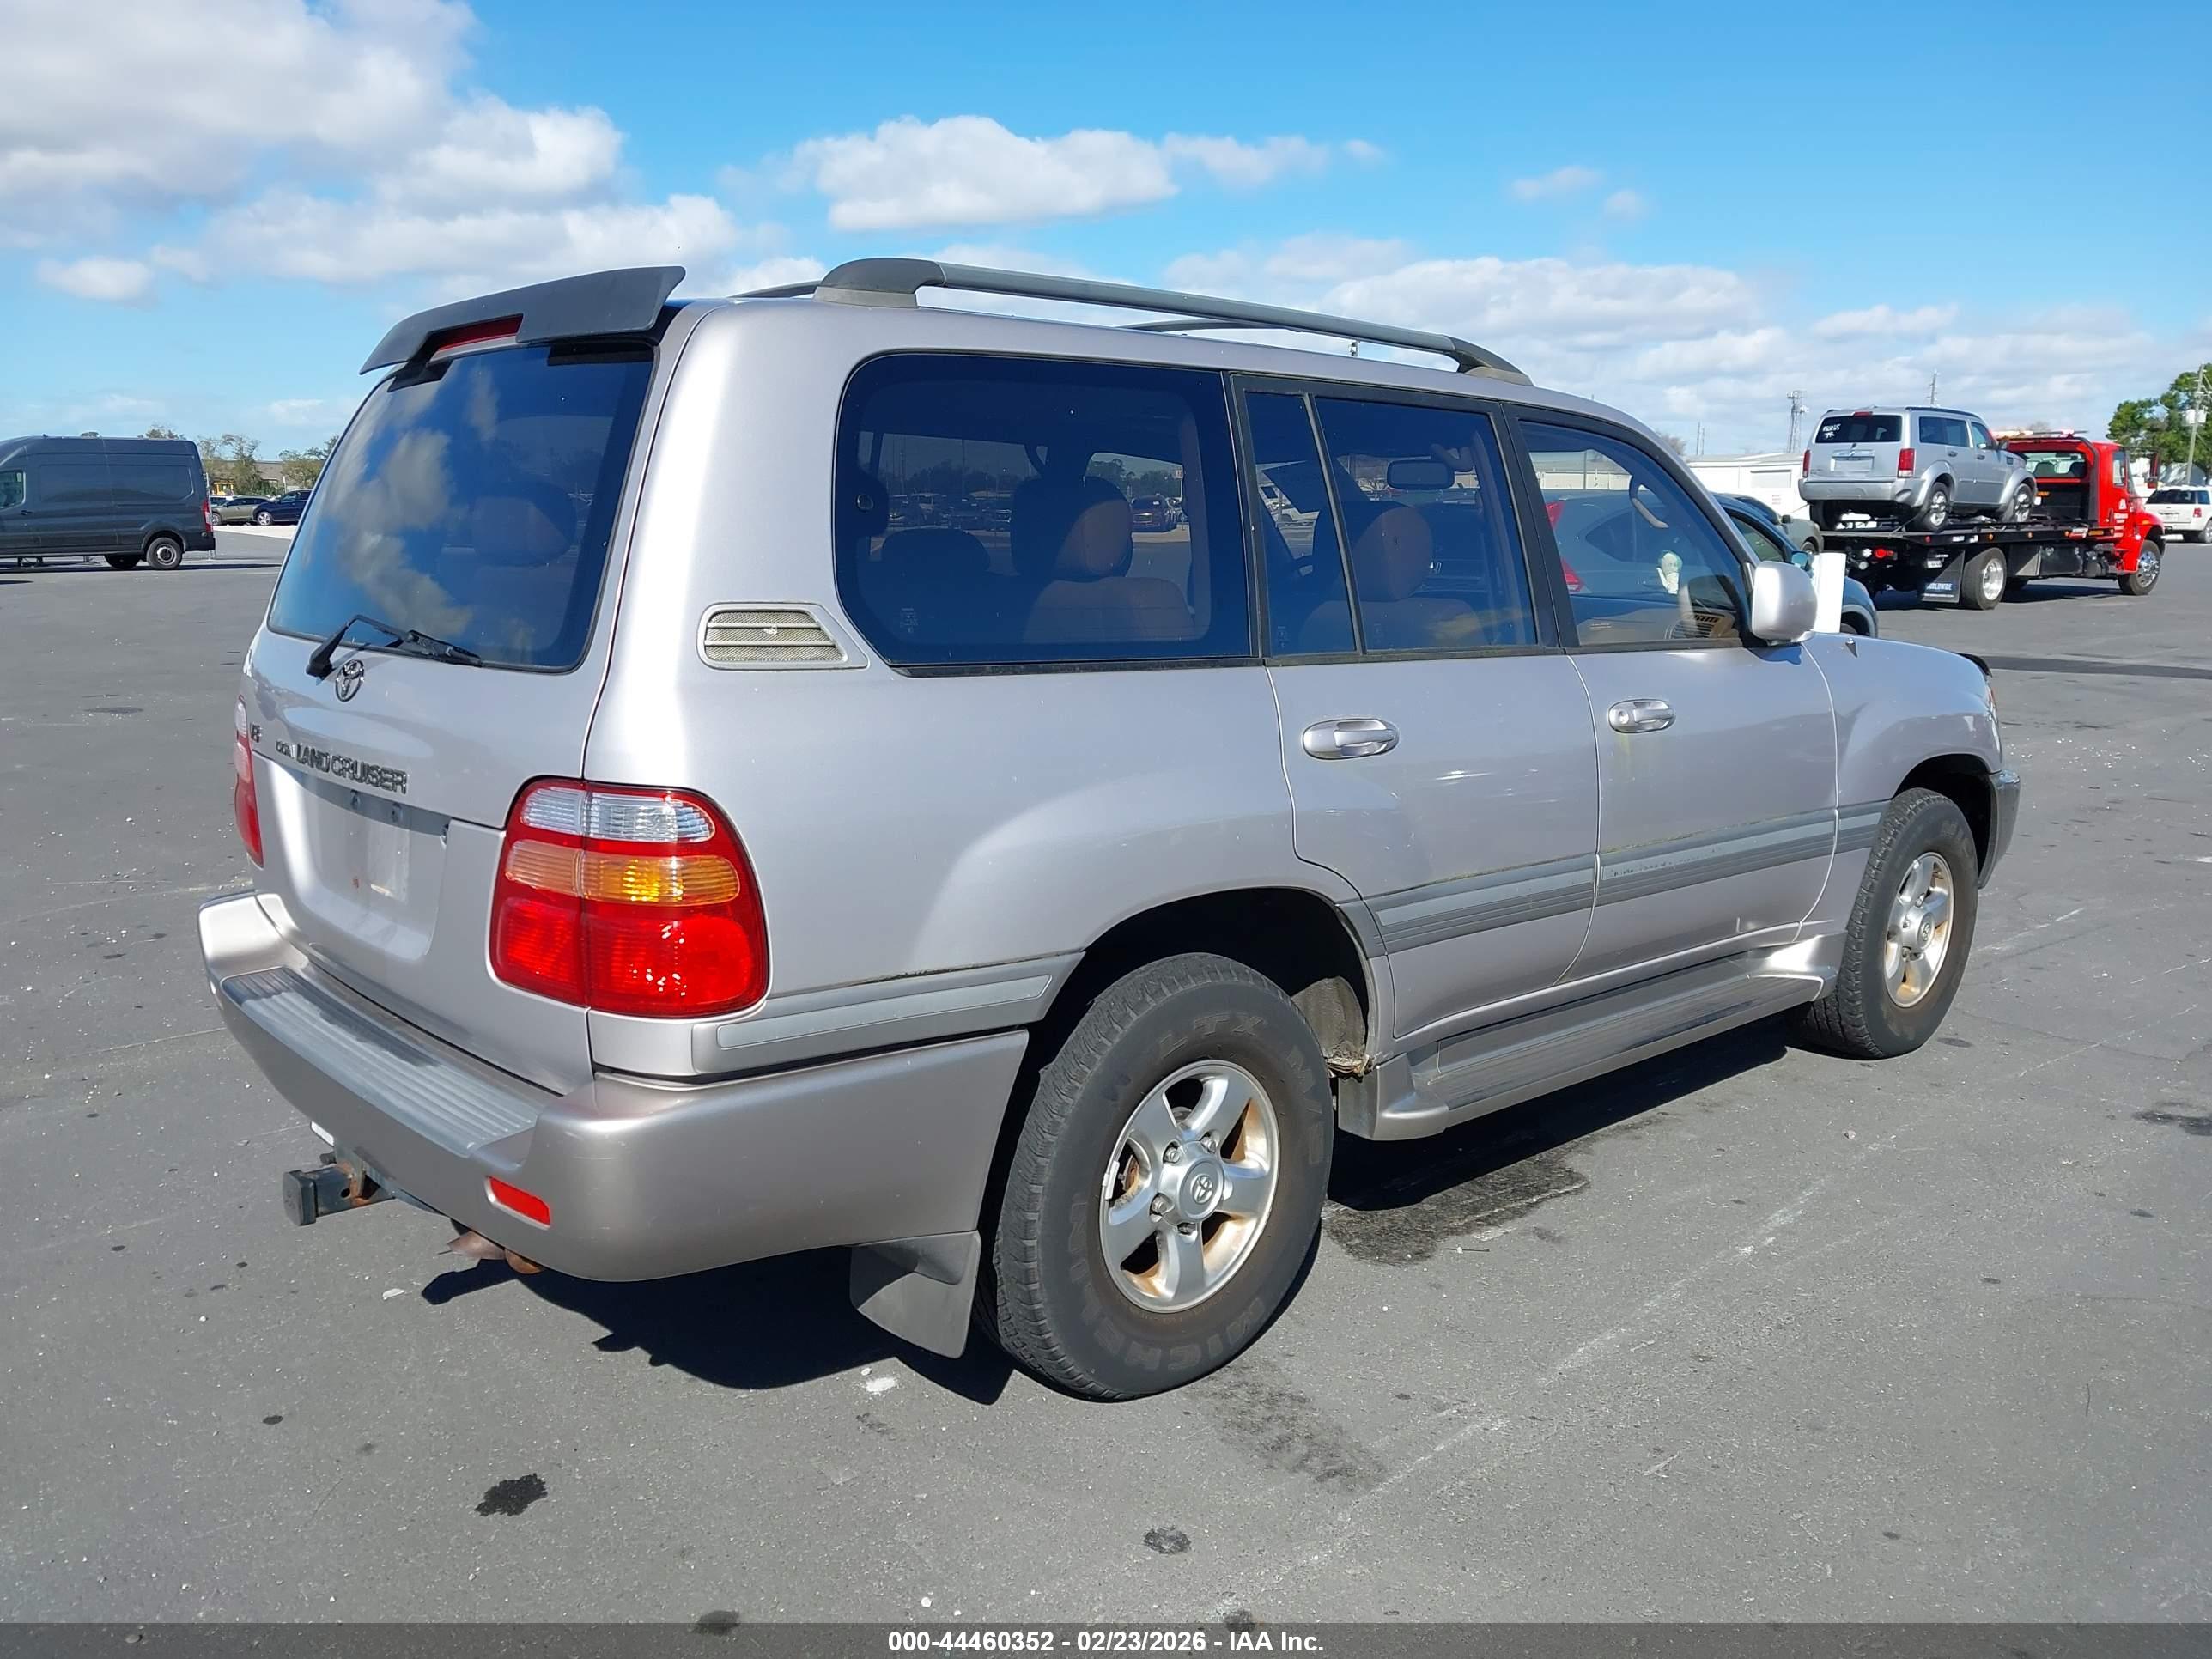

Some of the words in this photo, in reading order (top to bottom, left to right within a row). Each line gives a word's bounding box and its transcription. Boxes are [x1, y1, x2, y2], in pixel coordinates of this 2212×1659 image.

[296, 743, 331, 773] LAND
[331, 754, 410, 795] CRUISER
[1158, 1016, 1267, 1059] LTX
[1068, 1201, 1265, 1372] MICHELIN
